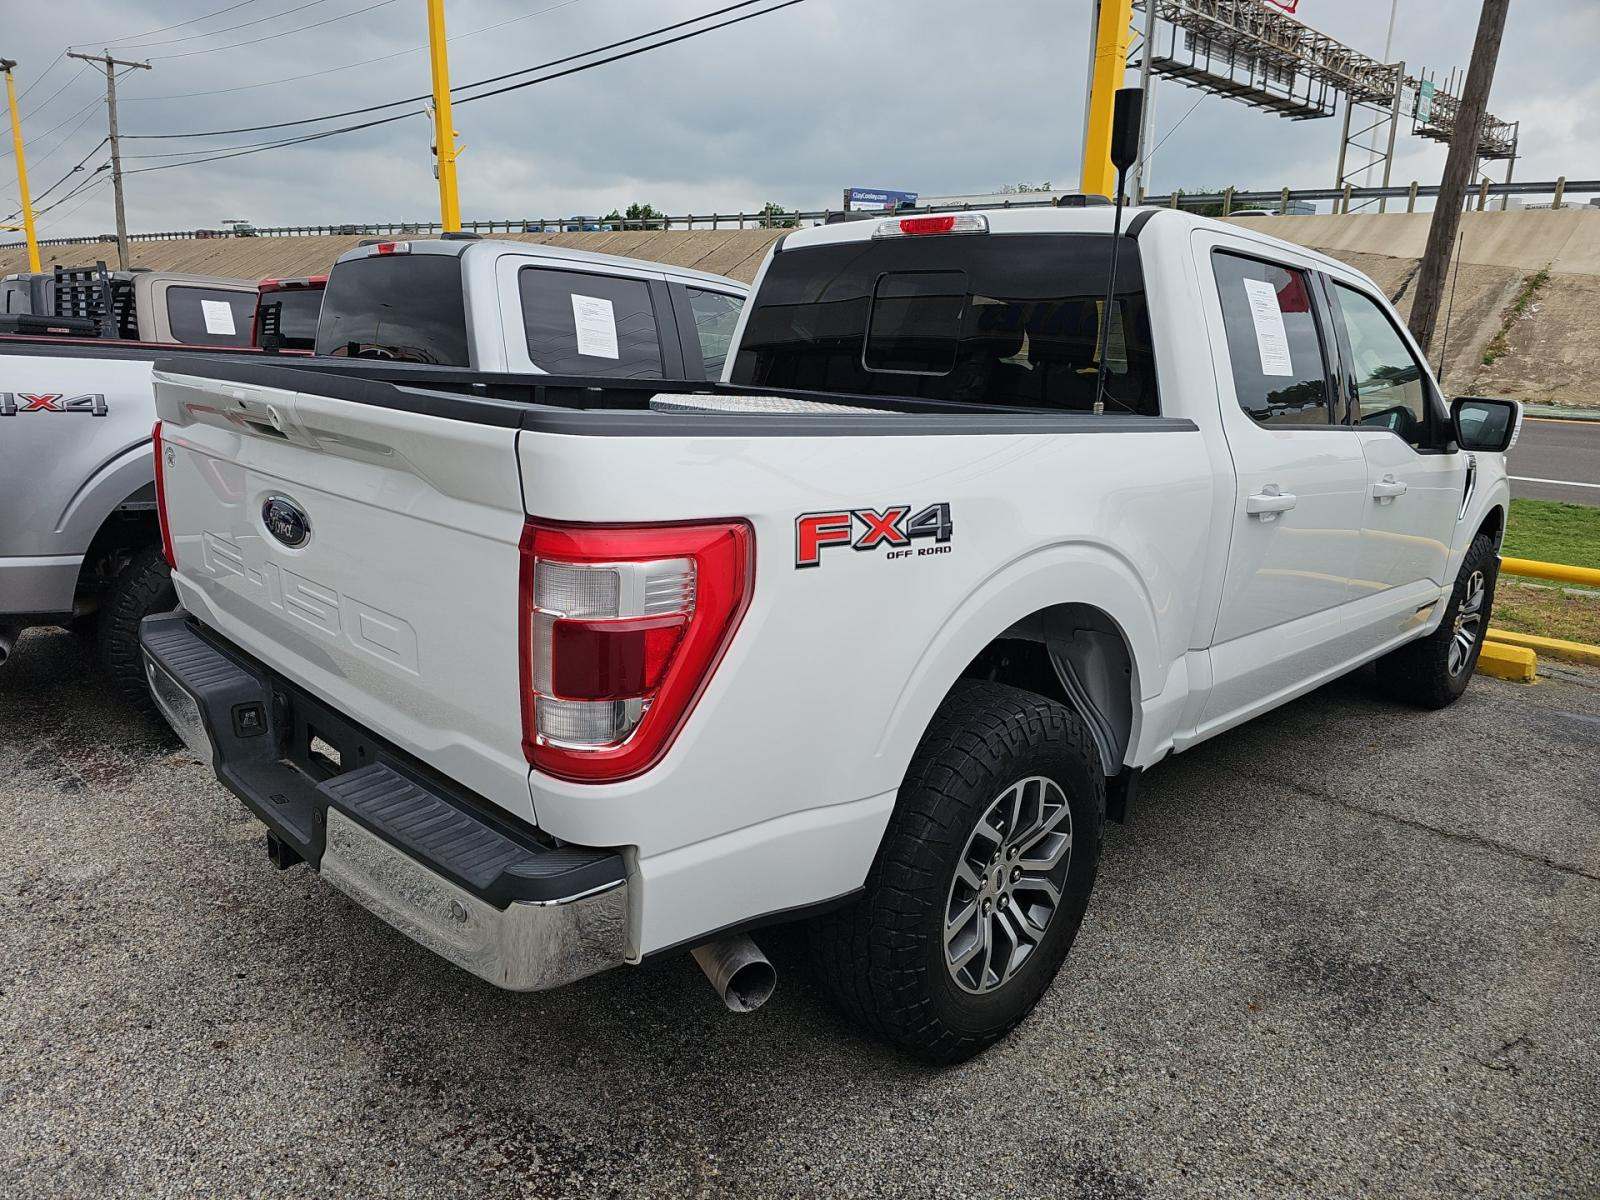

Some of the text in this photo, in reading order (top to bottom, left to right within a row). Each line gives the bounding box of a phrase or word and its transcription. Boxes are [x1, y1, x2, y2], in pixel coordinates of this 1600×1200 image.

[795, 502, 953, 569] FX4
[886, 546, 952, 560] OFF ROAD
